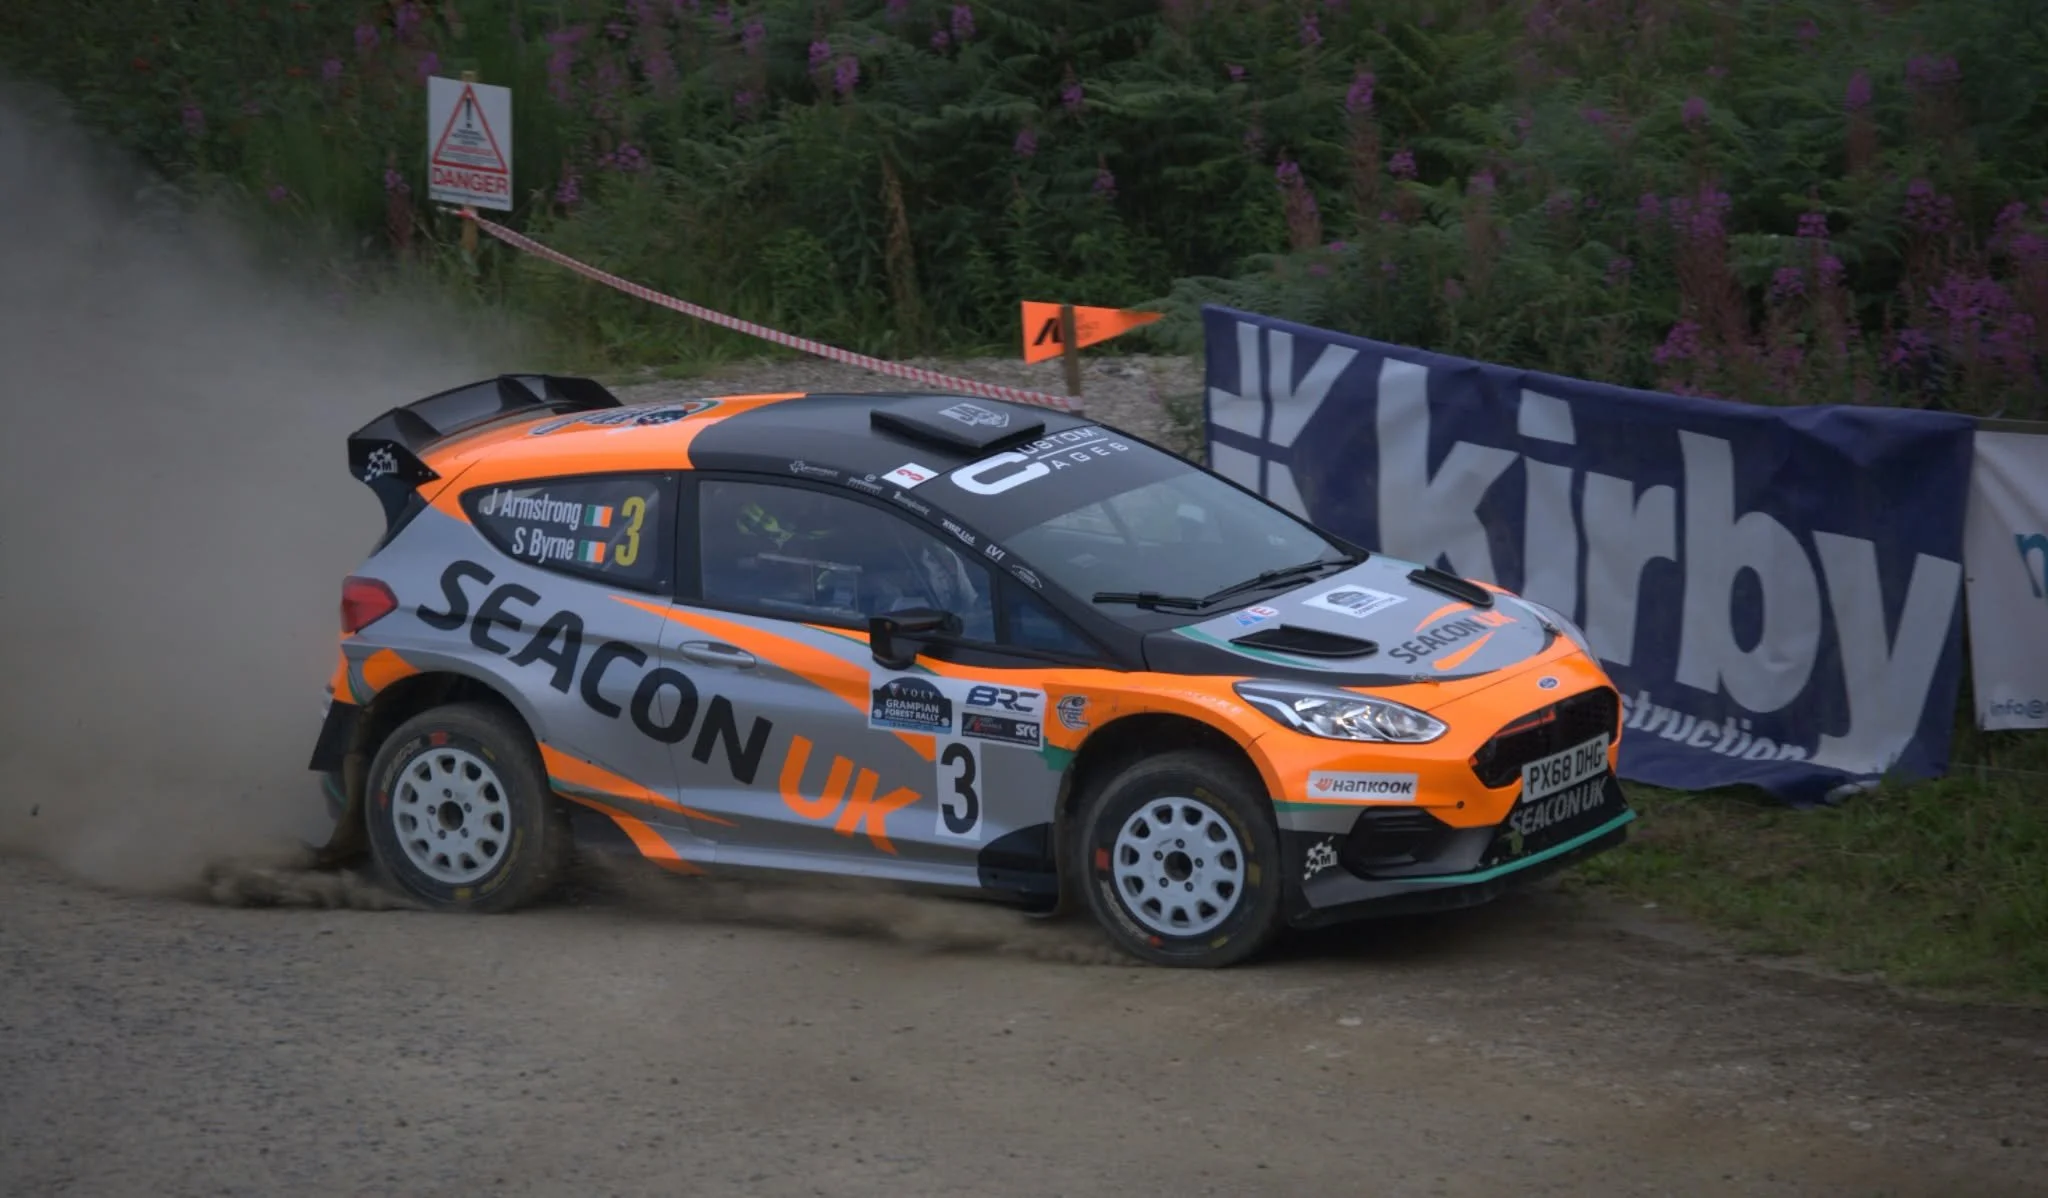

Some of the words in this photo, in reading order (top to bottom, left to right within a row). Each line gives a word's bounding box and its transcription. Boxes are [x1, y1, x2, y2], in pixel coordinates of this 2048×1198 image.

[432, 167, 509, 195] DANGER
[484, 488, 498, 515] J
[501, 490, 582, 531] Armstrong
[615, 496, 646, 566] 3
[512, 526, 527, 554] S
[529, 528, 575, 563] Byrne
[984, 544, 1006, 562] LVI
[1376, 355, 1962, 775] kirby
[1388, 618, 1488, 664] SEACON
[1470, 610, 1519, 627] UK
[416, 559, 773, 785] SEACON
[779, 735, 922, 856] UK
[885, 708, 914, 719] FOREST
[915, 711, 939, 721] RALLY
[886, 699, 939, 713] GRAMPIAN
[965, 685, 1040, 713] BRC
[940, 742, 979, 834] 3
[1529, 755, 1572, 795] PX68
[1575, 740, 1604, 777] DHG
[1509, 787, 1581, 836] SEACON
[1581, 775, 1608, 811] UK
